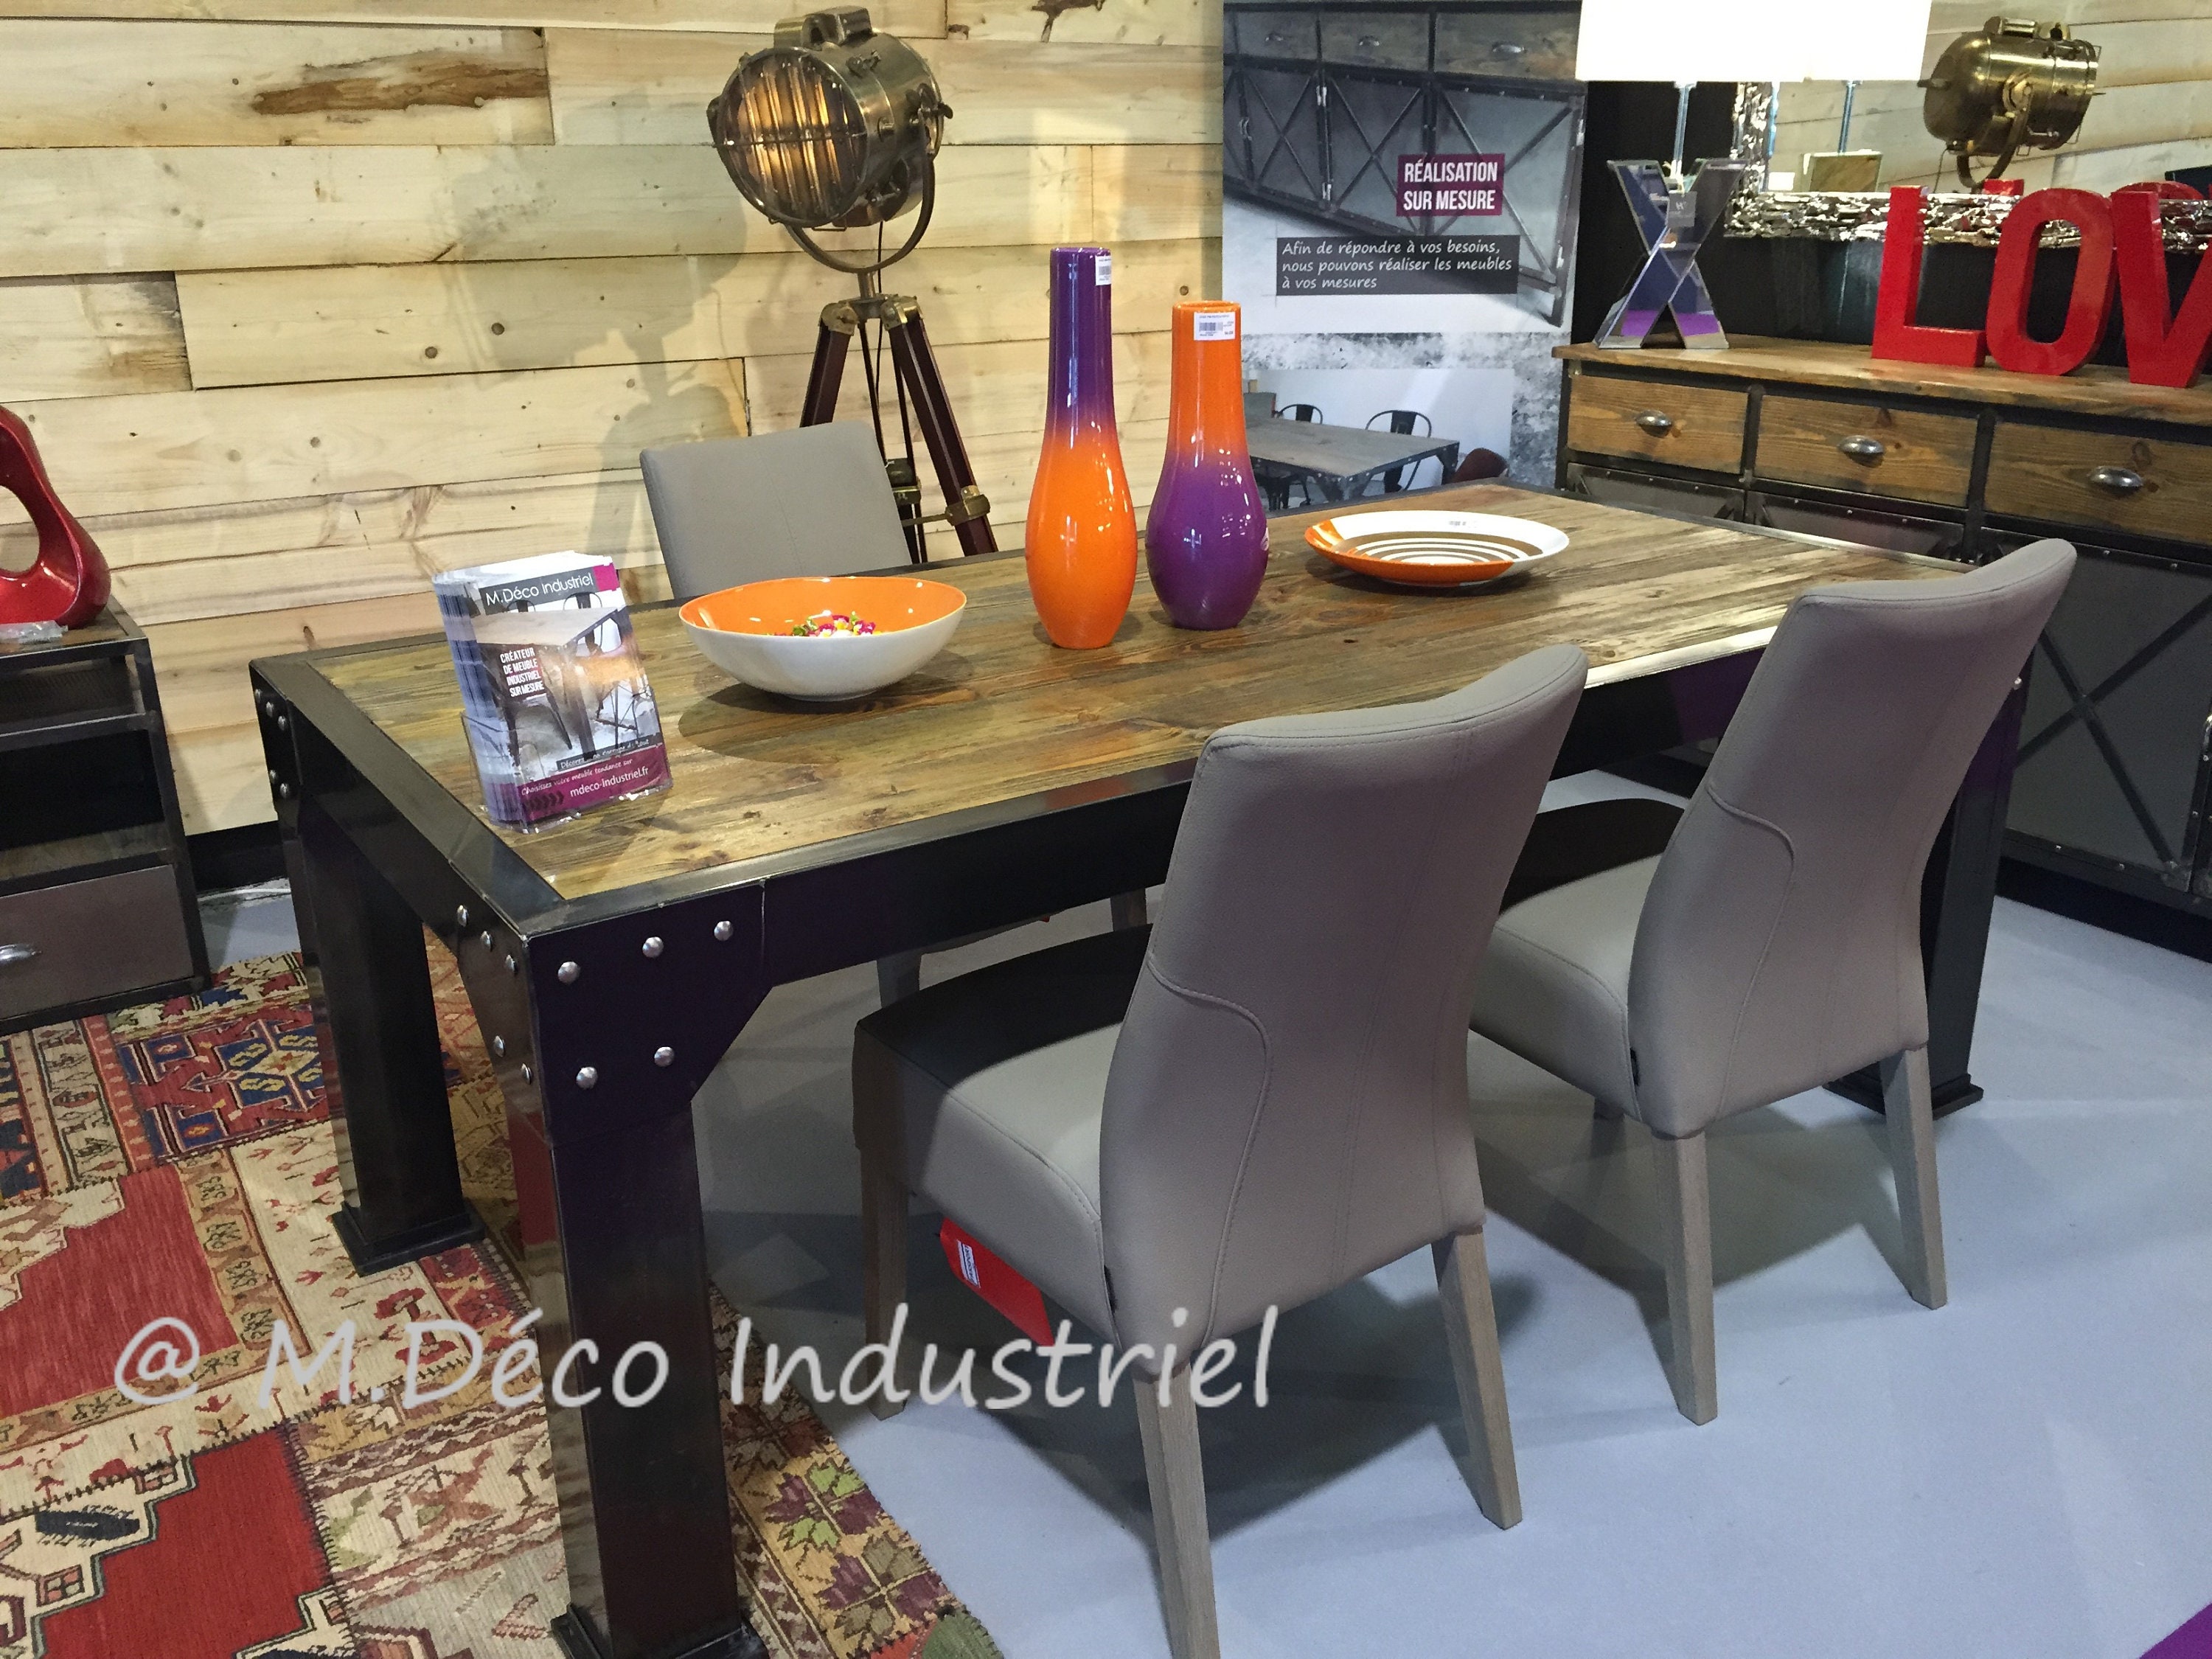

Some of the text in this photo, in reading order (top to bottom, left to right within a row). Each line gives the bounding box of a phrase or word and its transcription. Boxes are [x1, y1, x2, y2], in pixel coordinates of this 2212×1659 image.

[1404, 159, 1498, 183] RÉALISATION
[1403, 189, 1496, 211] SUR MESURE
[1281, 239, 1500, 258] Afin de répondre à vos besoins,
[1281, 256, 1512, 276] nous pouvons réaliser les meubles
[1281, 276, 1377, 289] à vos mesures
[485, 585, 539, 606] M.Déco
[500, 647, 535, 664] CRÉATEUR
[502, 658, 538, 675] DE MEUBLE
[506, 669, 542, 686] INDUSTRIEL
[509, 680, 545, 698] SUR MESURE
[521, 782, 552, 796] Choisissez
[571, 768, 593, 781] meuble
[594, 761, 622, 774] tendance
